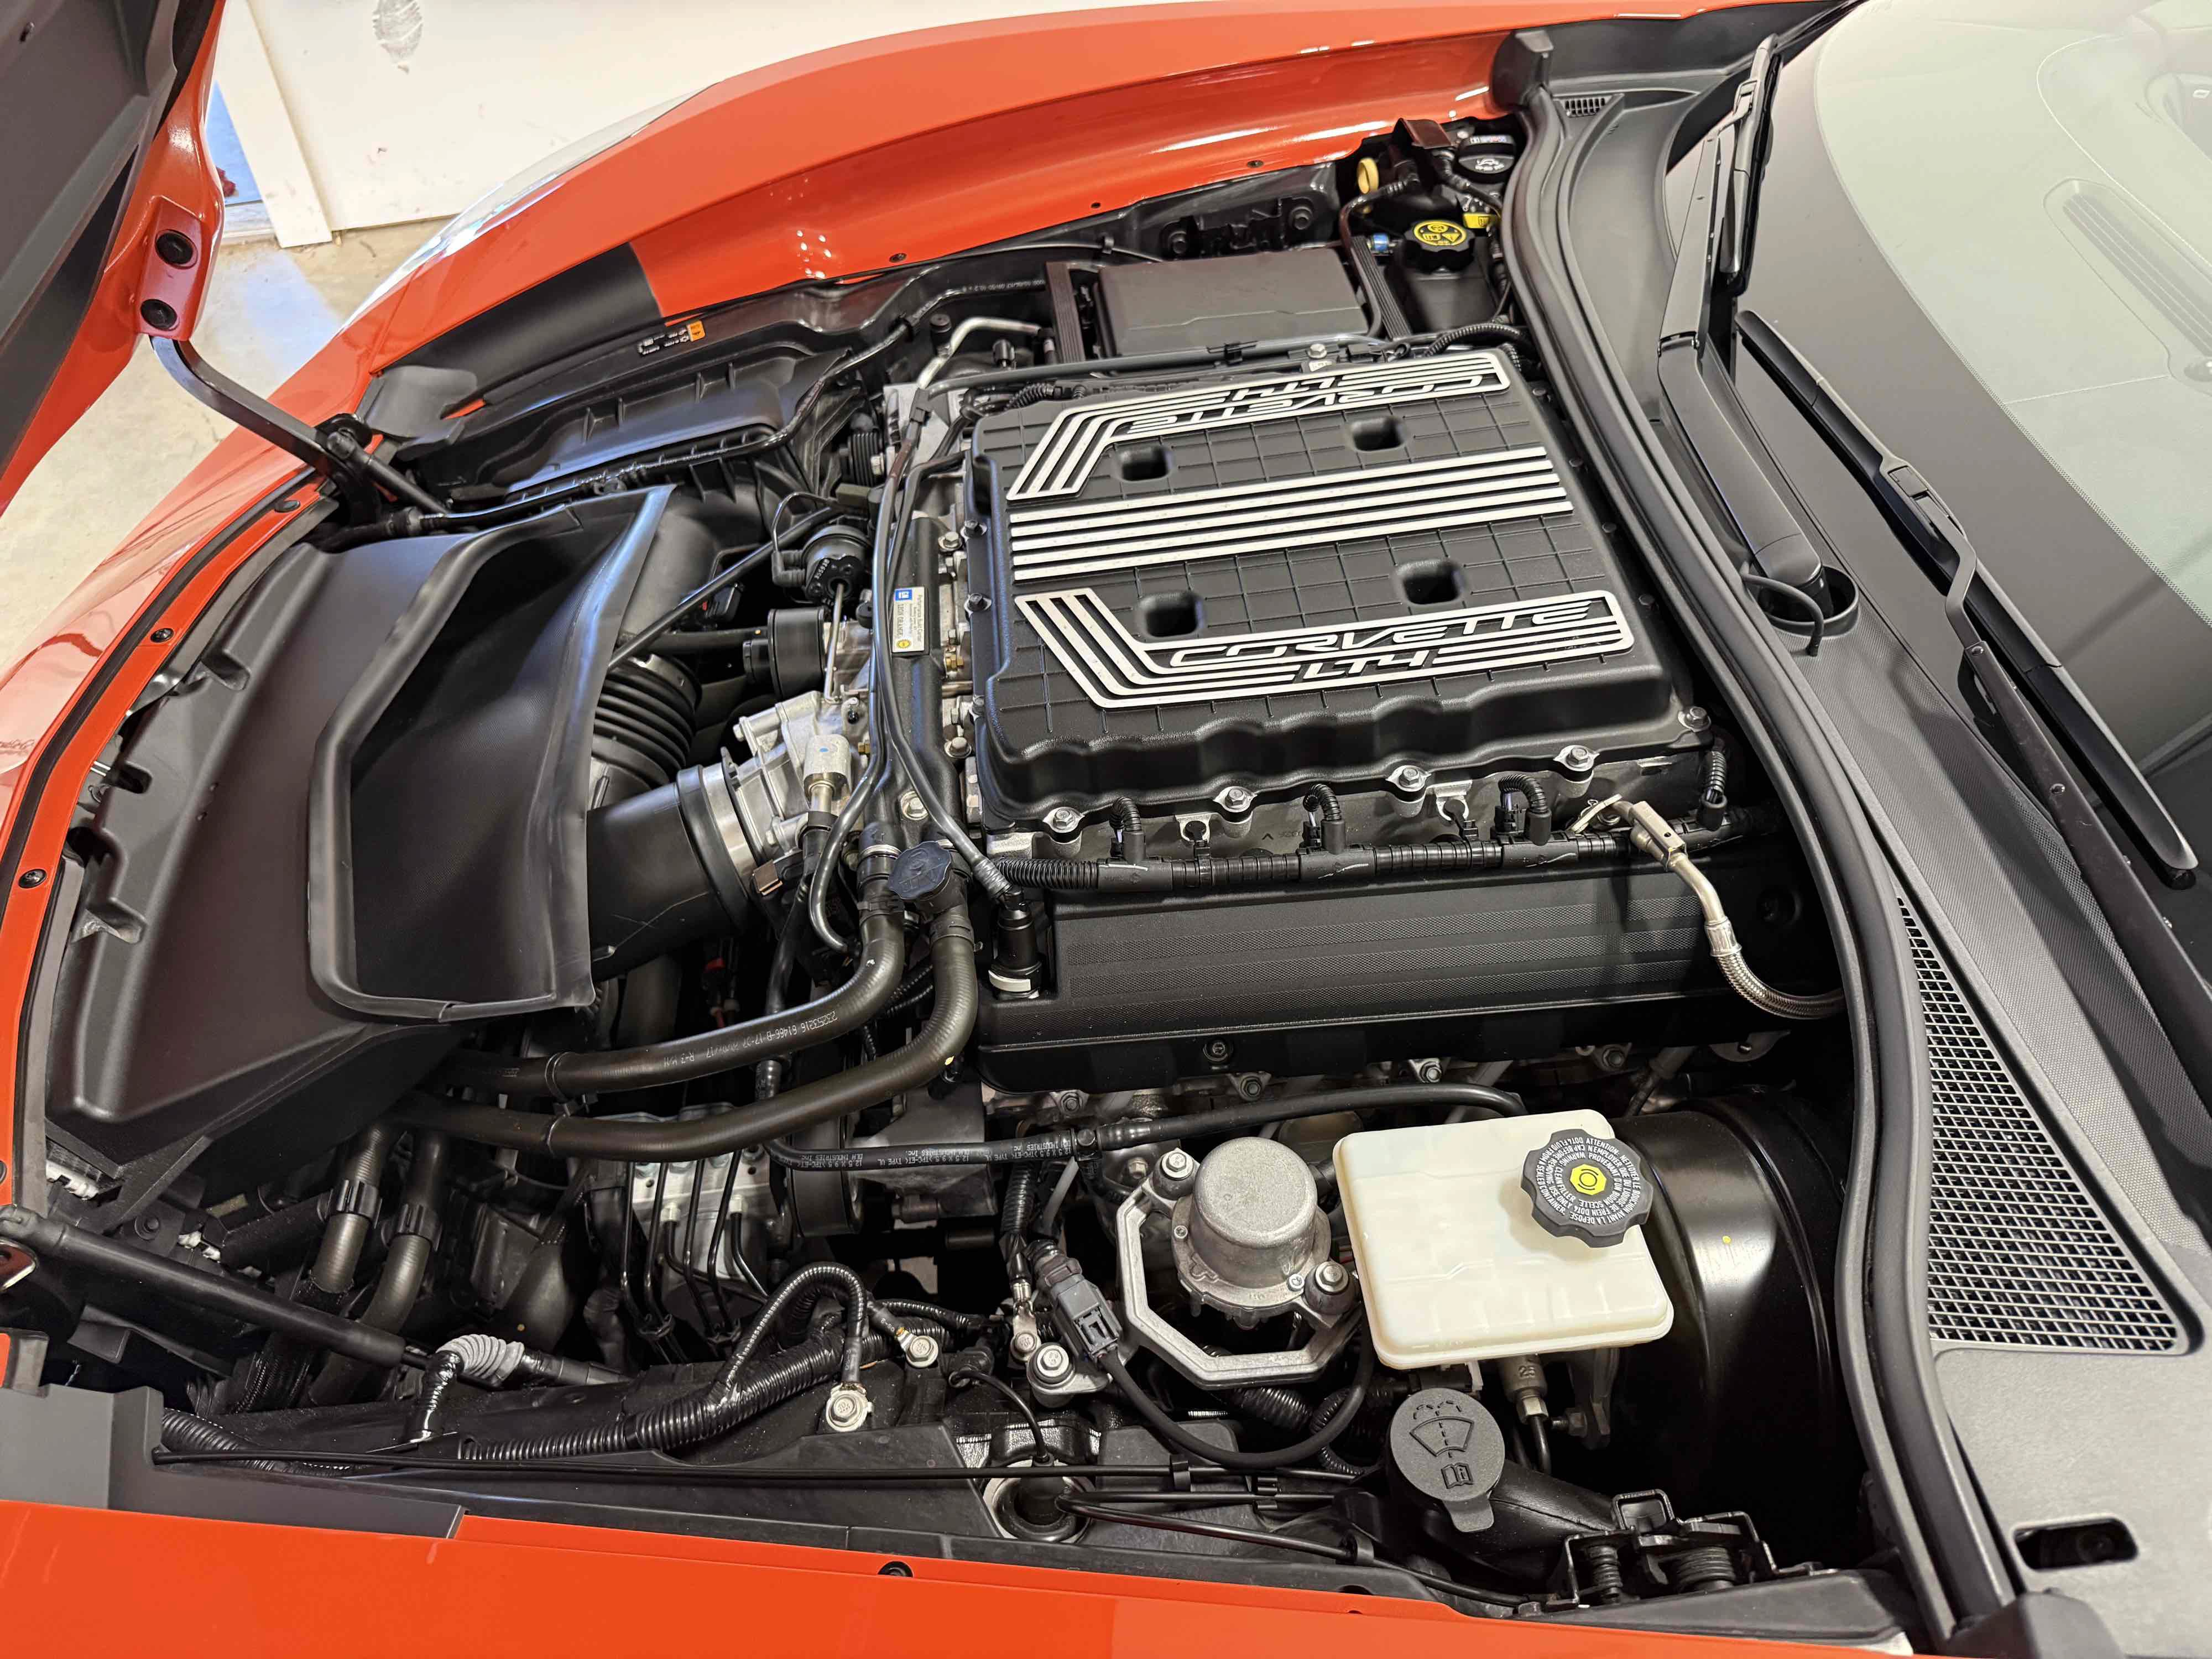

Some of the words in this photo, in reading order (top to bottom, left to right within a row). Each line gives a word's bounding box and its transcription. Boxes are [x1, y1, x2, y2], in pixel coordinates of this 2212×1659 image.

[1233, 376, 1339, 402] LT4
[1131, 375, 1481, 427] CORVETTE
[1170, 601, 1590, 667] CORVETTE
[1302, 649, 1430, 680] LT4
[799, 1010, 839, 1032] 23253216
[1551, 1139, 1568, 1151] FLUID
[1552, 1145, 1574, 1160] BEFORE
[1585, 1138, 1620, 1156] ATTENTION:
[1539, 1147, 1554, 1162] FROM
[1557, 1151, 1586, 1166] WARNING:
[1588, 1152, 1620, 1176] PROVENANT
[1619, 1155, 1640, 1181] NETTOYER
[1536, 1165, 1546, 1185] SEALED
[1554, 1166, 1563, 1184] CLEAN
[1619, 1167, 1630, 1178] QUE
[1623, 1179, 1632, 1187] DU
[1549, 1186, 1561, 1197] USE
[1557, 1183, 1576, 1202] FILLER
[1603, 1191, 1621, 1206] BIDON
[1616, 1187, 1632, 1207] LIQUIDE
[1557, 1195, 1573, 1209] ONLY
[1578, 1198, 1604, 1209] SCELLE
[1609, 1204, 1619, 1212] DE
[1623, 1189, 1641, 1214] BOUCHON
[1569, 1211, 1595, 1224] DEPOSE
[1573, 1206, 1589, 1215] DOT4
[1591, 1207, 1611, 1217] FREIN
[1606, 1209, 1625, 1223] AVANT
[1596, 1217, 1606, 1225] LA
